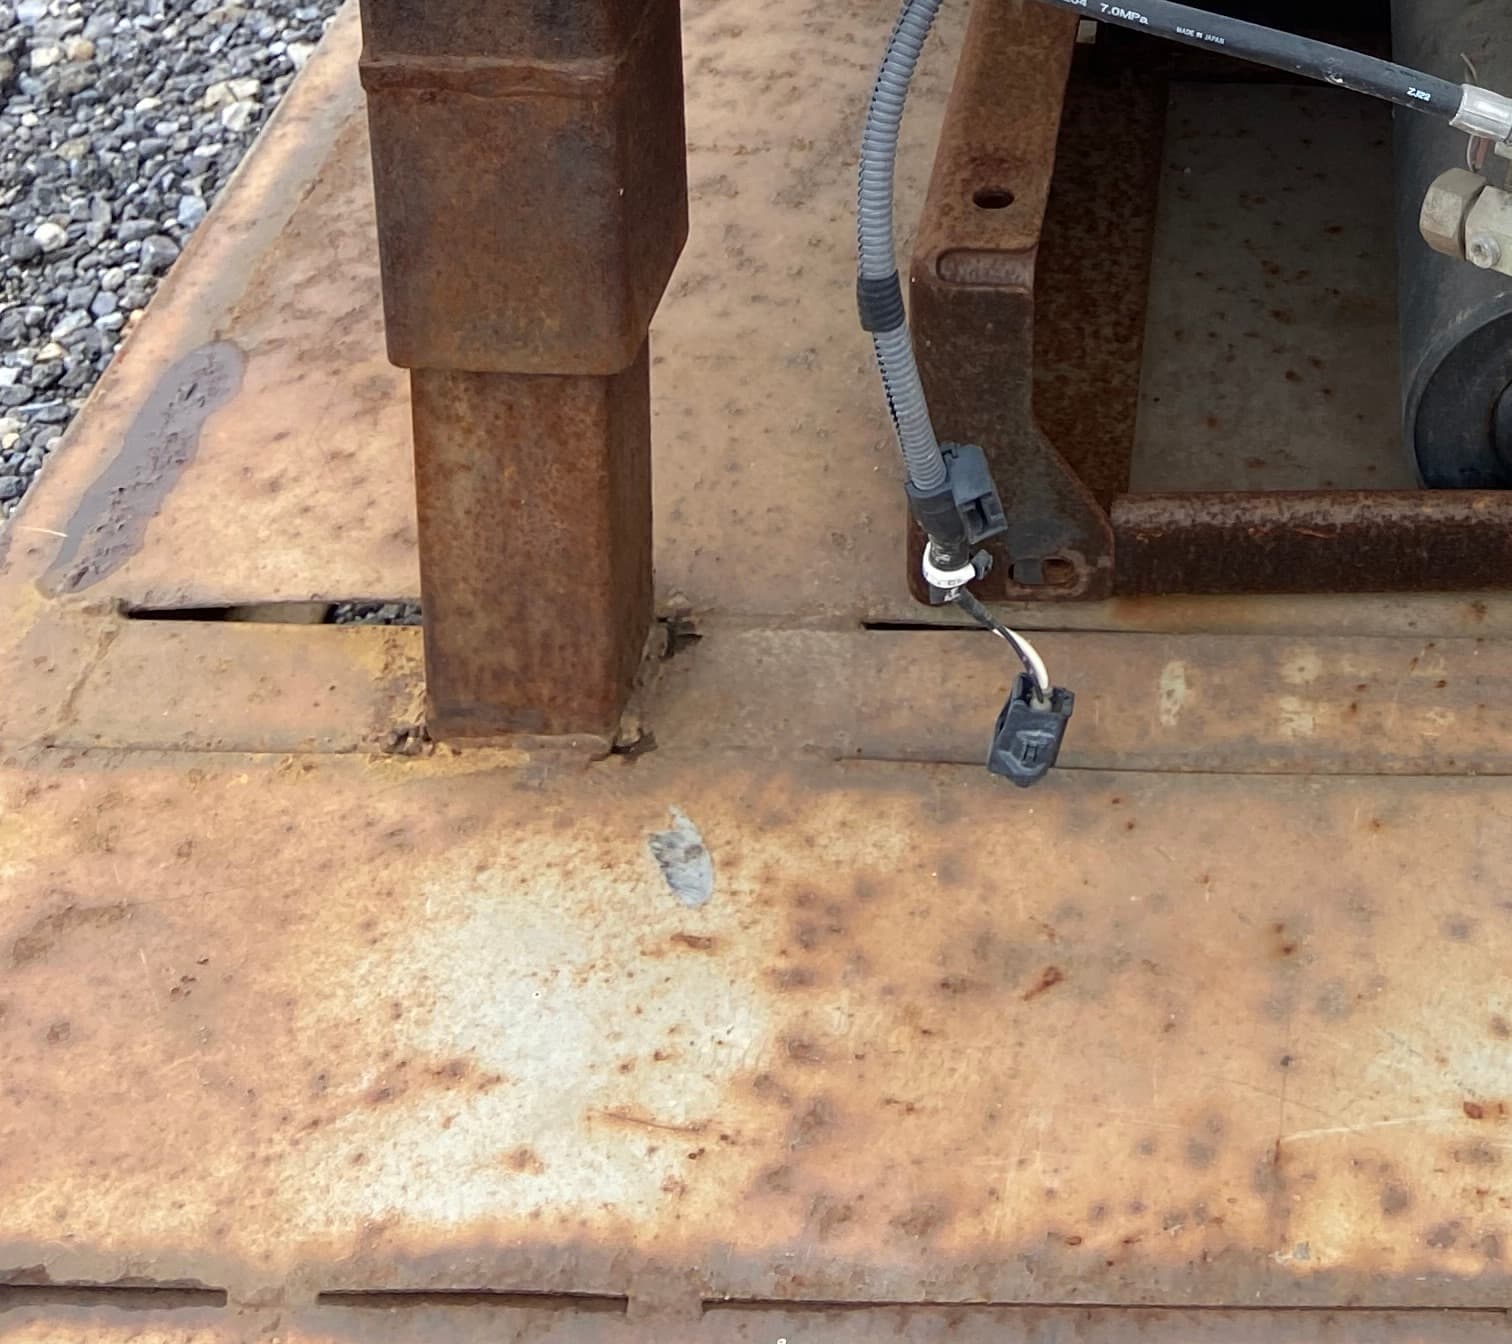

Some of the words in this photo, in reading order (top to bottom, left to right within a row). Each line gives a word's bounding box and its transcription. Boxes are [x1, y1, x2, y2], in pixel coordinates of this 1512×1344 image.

[1100, 2, 1149, 26] 7.0MPa
[1176, 26, 1195, 38] MADE
[1204, 32, 1226, 46] JAPAN
